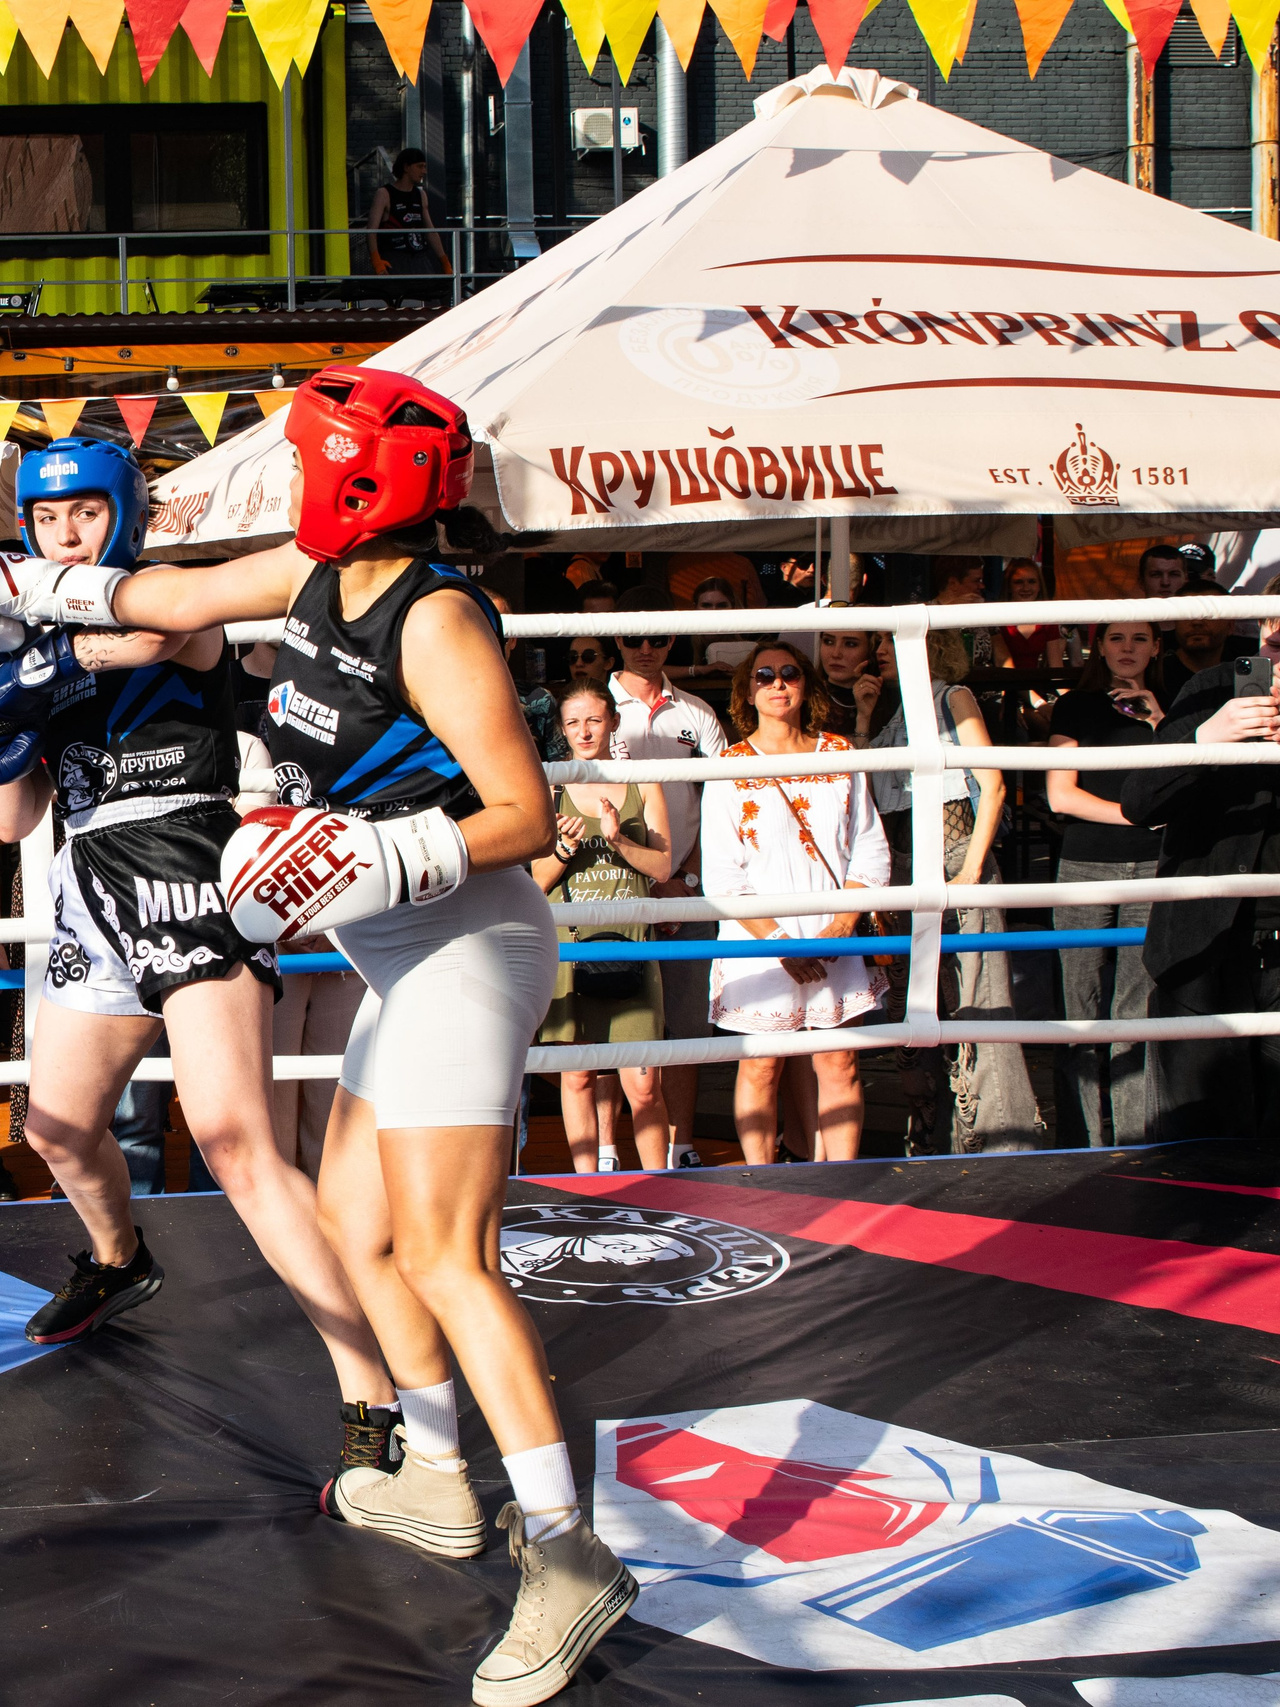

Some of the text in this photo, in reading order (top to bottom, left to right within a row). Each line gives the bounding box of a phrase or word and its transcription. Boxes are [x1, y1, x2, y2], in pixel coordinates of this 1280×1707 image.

[734, 298, 1238, 352] KRÓNPRINZ
[39, 460, 79, 479] clinch
[988, 467, 1189, 486] EST. 1581
[264, 496, 282, 513] 1581
[65, 598, 95, 606] GREEN
[67, 604, 92, 612] HILL
[289, 690, 340, 732] БИТВА
[119, 750, 186, 774] КРУТОЯР
[253, 818, 349, 904] GREEN
[596, 853, 615, 864] MY
[268, 849, 356, 921] HILL
[575, 868, 634, 884] FAVORITE
[296, 875, 351, 926] BE YOUR BEST SELF
